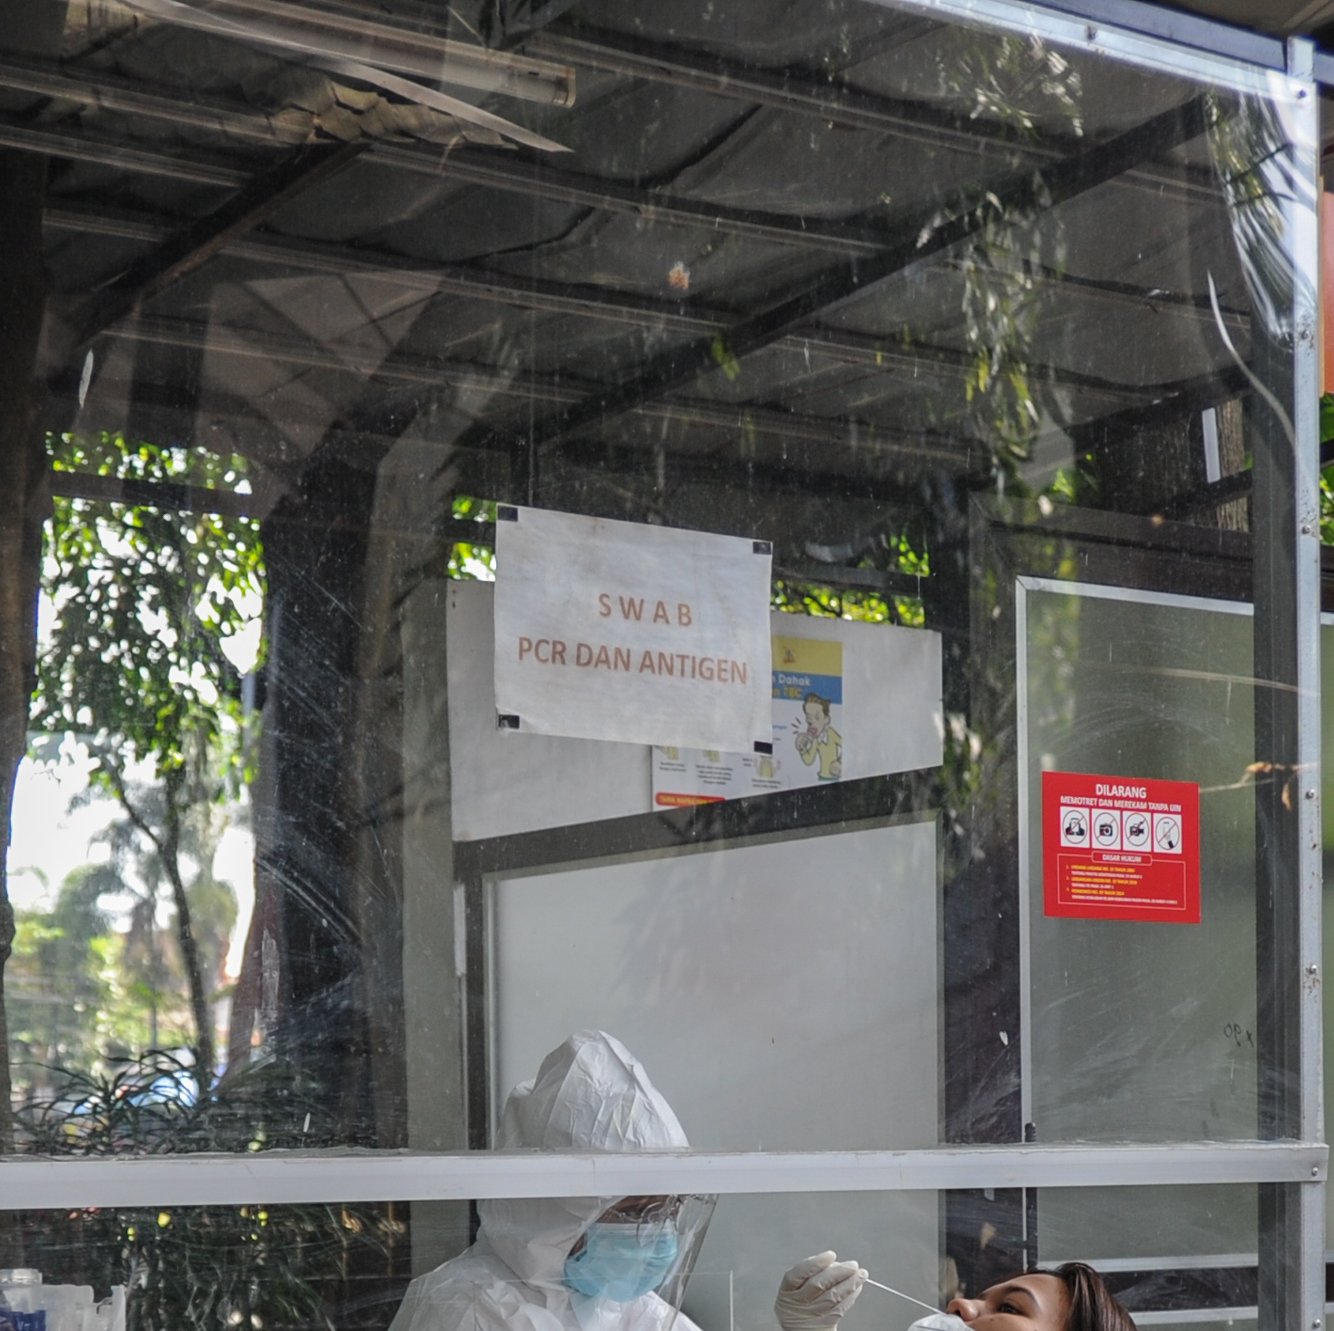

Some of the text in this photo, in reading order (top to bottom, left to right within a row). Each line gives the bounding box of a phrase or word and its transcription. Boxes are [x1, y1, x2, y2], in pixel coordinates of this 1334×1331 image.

[518, 637, 748, 686] PCR DAN ANTIGEN
[778, 674, 811, 687] Dahak
[1096, 783, 1147, 798] DILARANG
[1060, 796, 1097, 807] MEMOTRET
[1098, 798, 1113, 808] DAN
[1114, 800, 1147, 810] MEREKAM
[1148, 802, 1168, 812] TANPA
